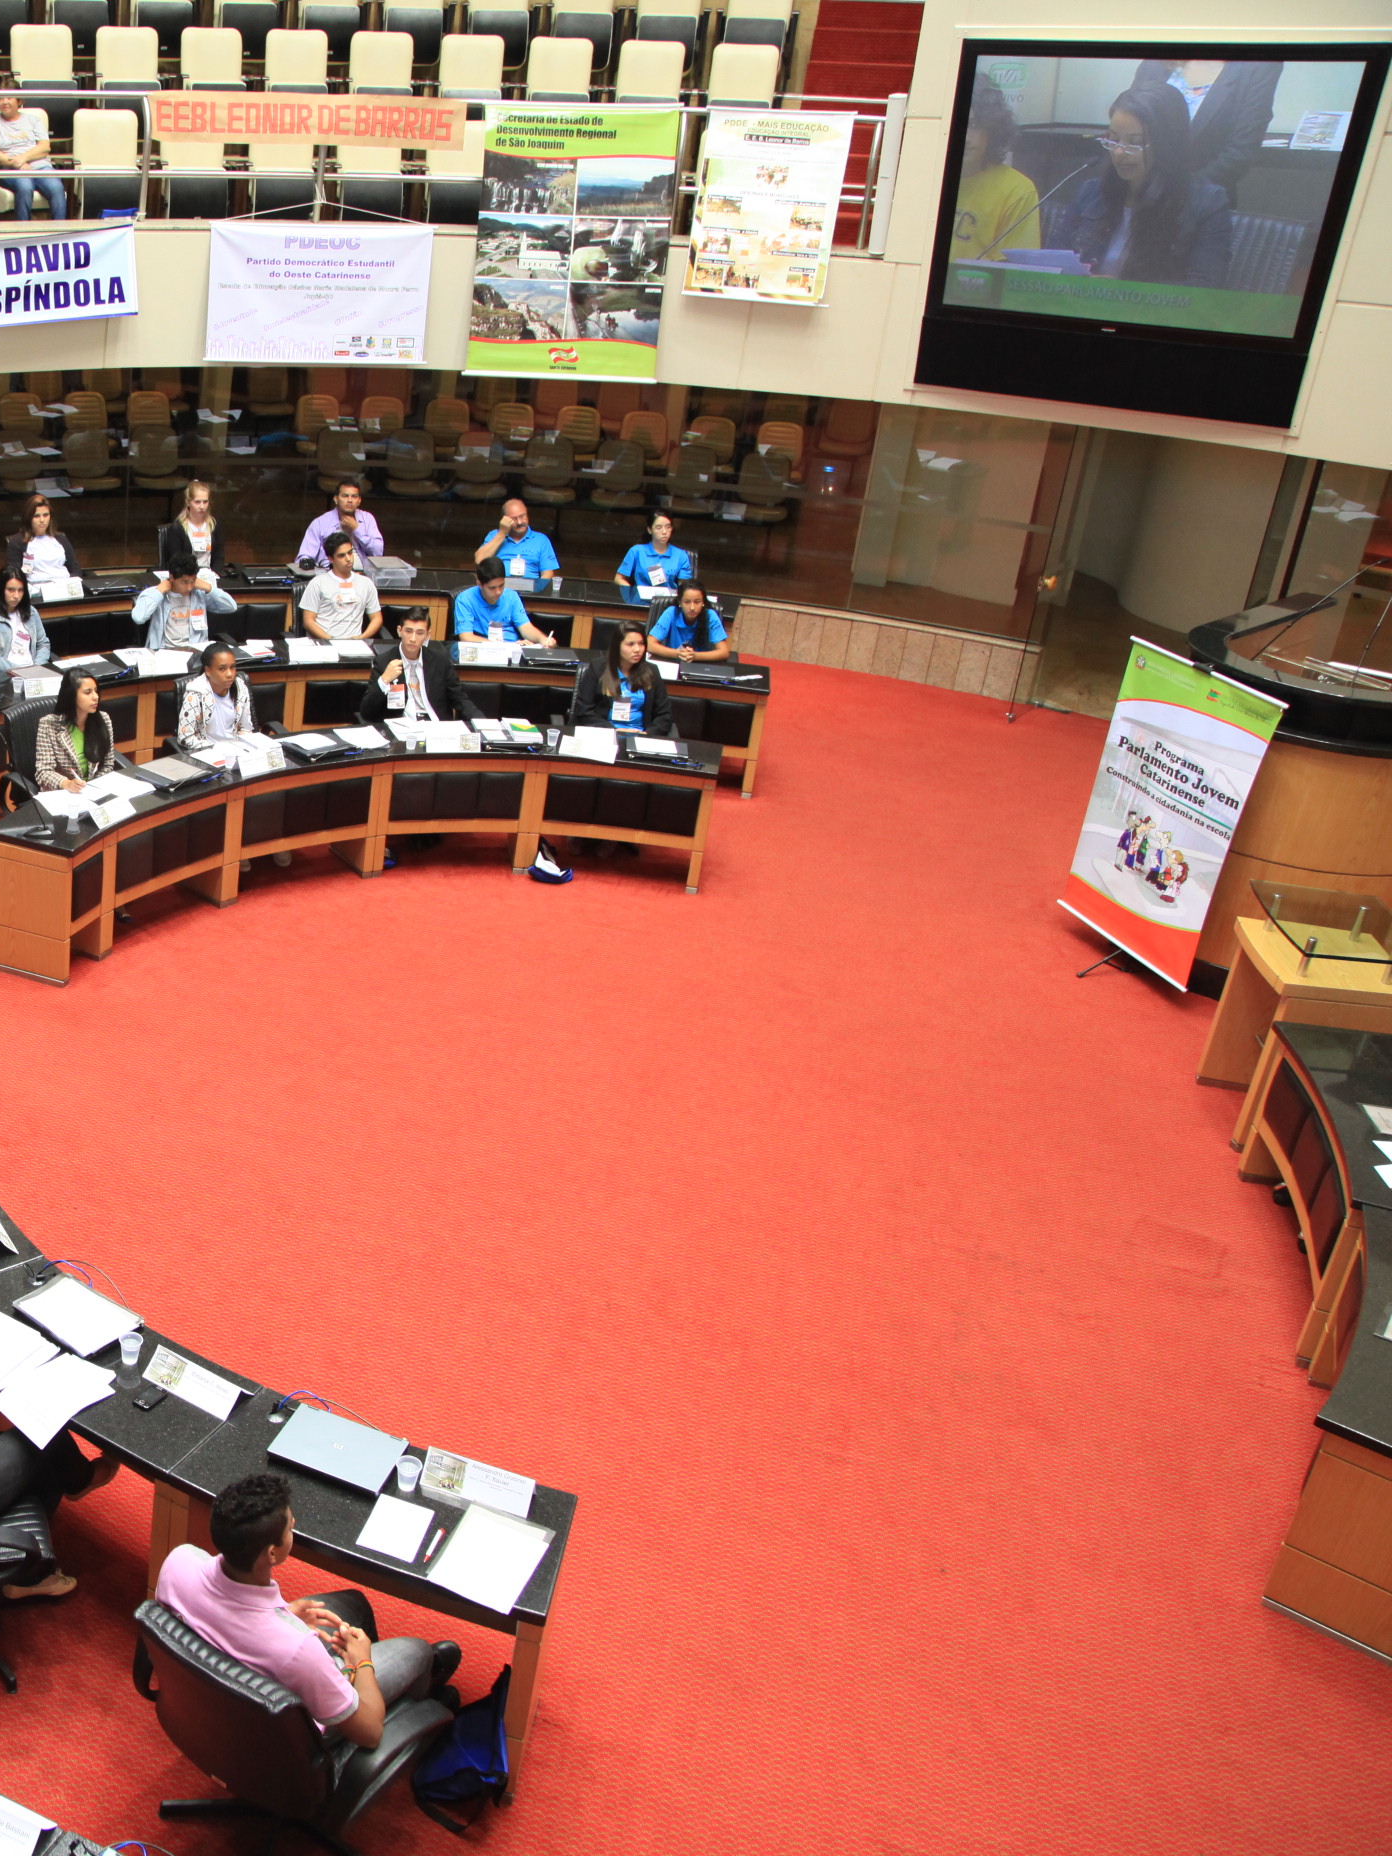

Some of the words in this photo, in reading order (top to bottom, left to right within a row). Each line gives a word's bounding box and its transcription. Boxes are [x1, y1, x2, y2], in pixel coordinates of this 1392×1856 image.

[354, 104, 454, 141] BARROS
[560, 116, 590, 125] Estado
[591, 117, 603, 126] de
[757, 121, 778, 129] MAIS
[780, 122, 830, 133] EDUCAÇÃO
[496, 125, 574, 137] Desenvolvimento
[576, 128, 616, 139] Regional
[495, 137, 507, 147] de
[508, 137, 526, 148] São
[527, 140, 565, 150] Joaquim
[3, 241, 91, 276] DAVID
[246, 257, 282, 266] Partido
[284, 258, 345, 267] Democrático
[347, 259, 395, 268] Estudantil
[269, 270, 281, 278] do
[284, 271, 312, 279] Oeste
[314, 271, 371, 280] Catarinense
[1055, 283, 1142, 303] PARLAMENTO
[1143, 291, 1190, 308] JOVEM
[1154, 740, 1205, 776] Programa
[1117, 735, 1189, 784] Parlamento
[1191, 777, 1240, 811] Jovem
[1139, 763, 1205, 808] Catarinense
[1106, 766, 1151, 796] Construindo
[1155, 796, 1193, 821] cidadania
[1194, 818, 1205, 827] na
[1205, 822, 1231, 841] escola
[5, 1822, 30, 1839] Bastiani
